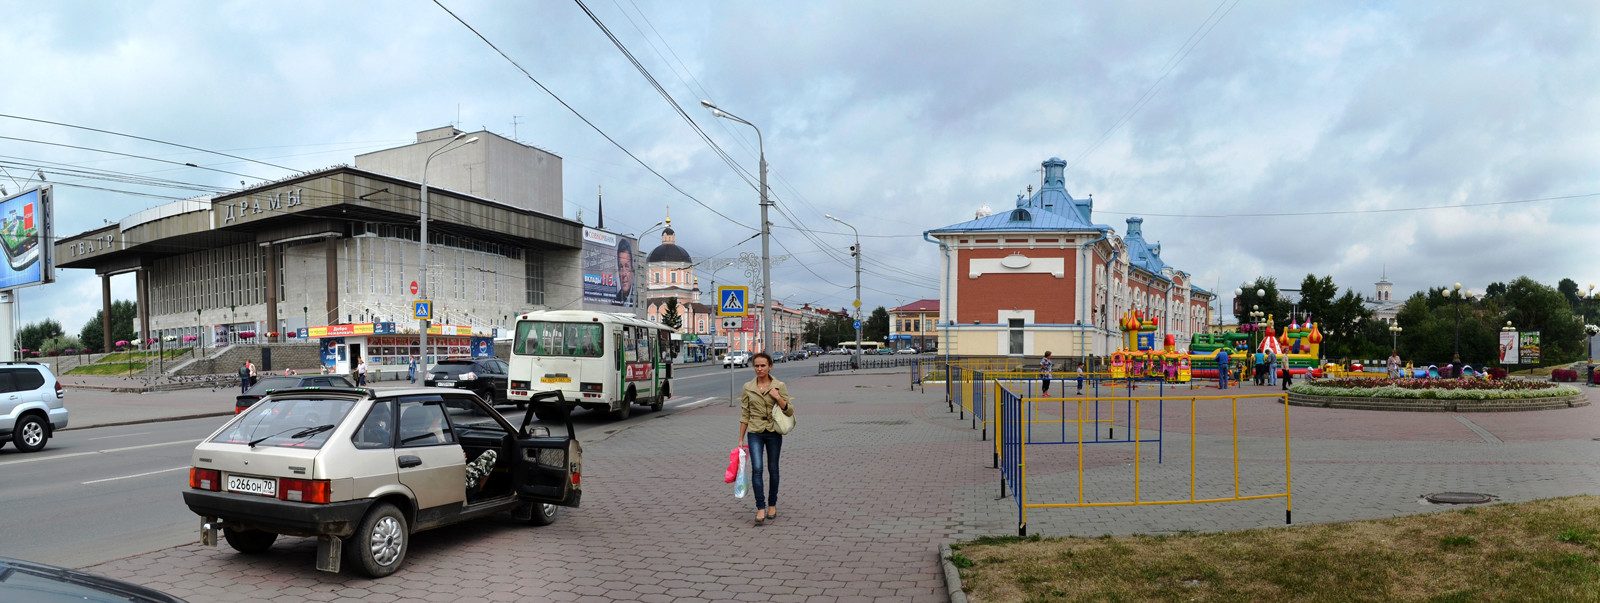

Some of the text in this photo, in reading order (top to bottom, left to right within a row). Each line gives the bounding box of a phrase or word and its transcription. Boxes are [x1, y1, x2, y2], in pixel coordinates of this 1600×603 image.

[70, 188, 303, 257] ТЕАТР ДРАМЫ
[263, 480, 273, 490] 70
